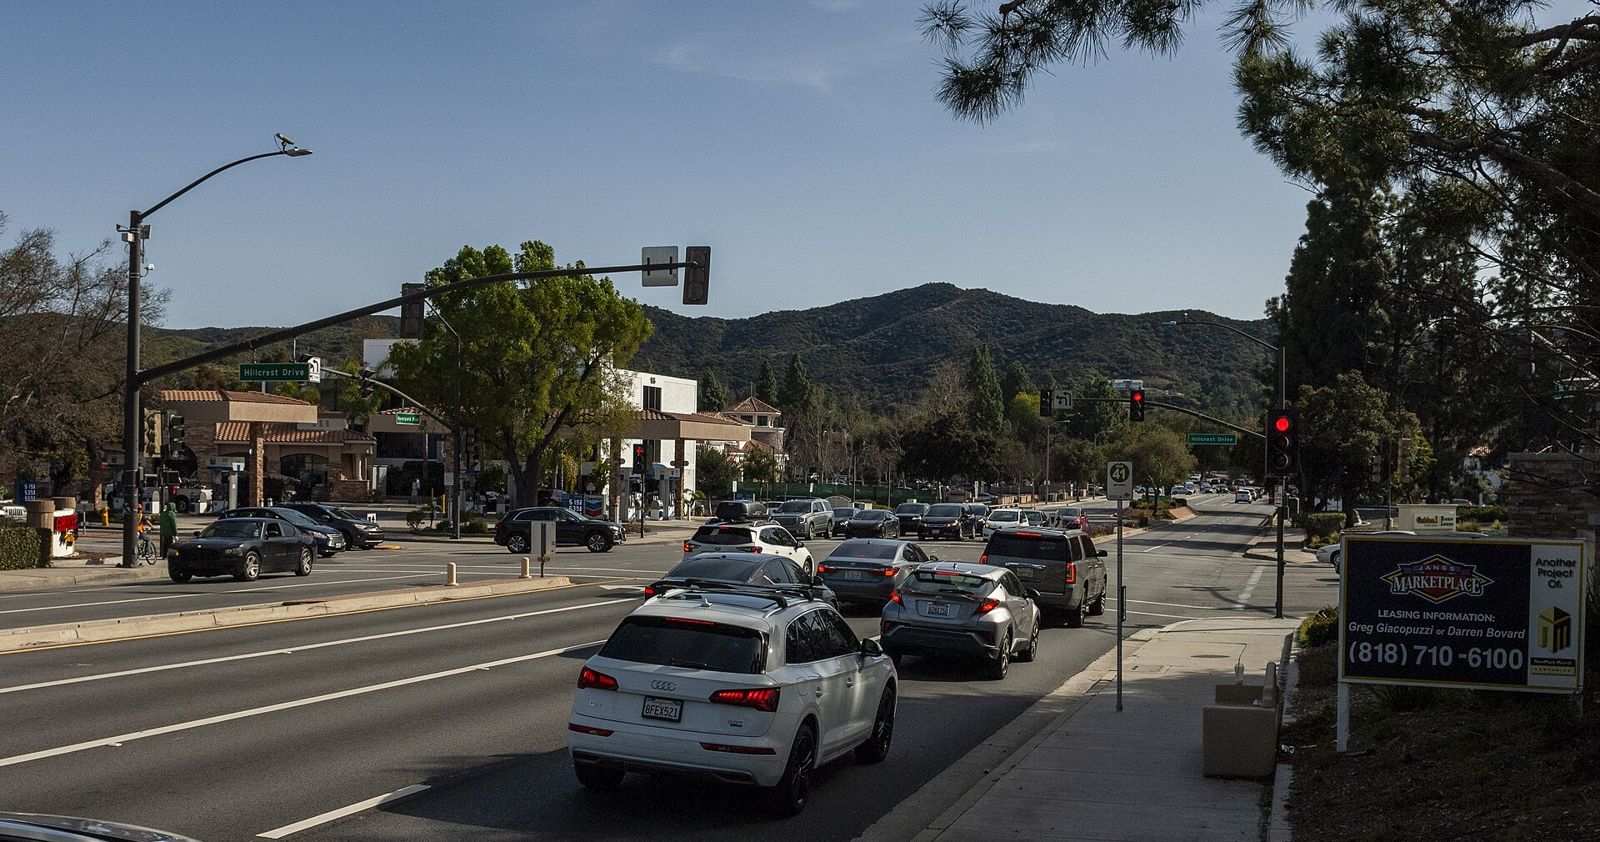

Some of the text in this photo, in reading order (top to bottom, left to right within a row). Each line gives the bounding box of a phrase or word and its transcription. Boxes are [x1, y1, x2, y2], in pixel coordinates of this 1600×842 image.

[244, 368, 305, 377] Hillcrest Drive
[1112, 468, 1126, 480] 41
[1418, 564, 1456, 572] JANSS
[1535, 558, 1576, 568] Another
[1537, 568, 1573, 579] Project
[1393, 575, 1481, 593] MARKETPLACE
[1378, 609, 1495, 622] LEASING INFORMATION:
[1348, 622, 1373, 634] Greg
[1376, 623, 1434, 635] Giacopuzzi
[1447, 626, 1484, 637] Darren
[1486, 627, 1526, 639] Bovard
[1349, 641, 1408, 666] (818)
[1413, 644, 1453, 667] 710
[645, 704, 678, 718] 8FEX521
